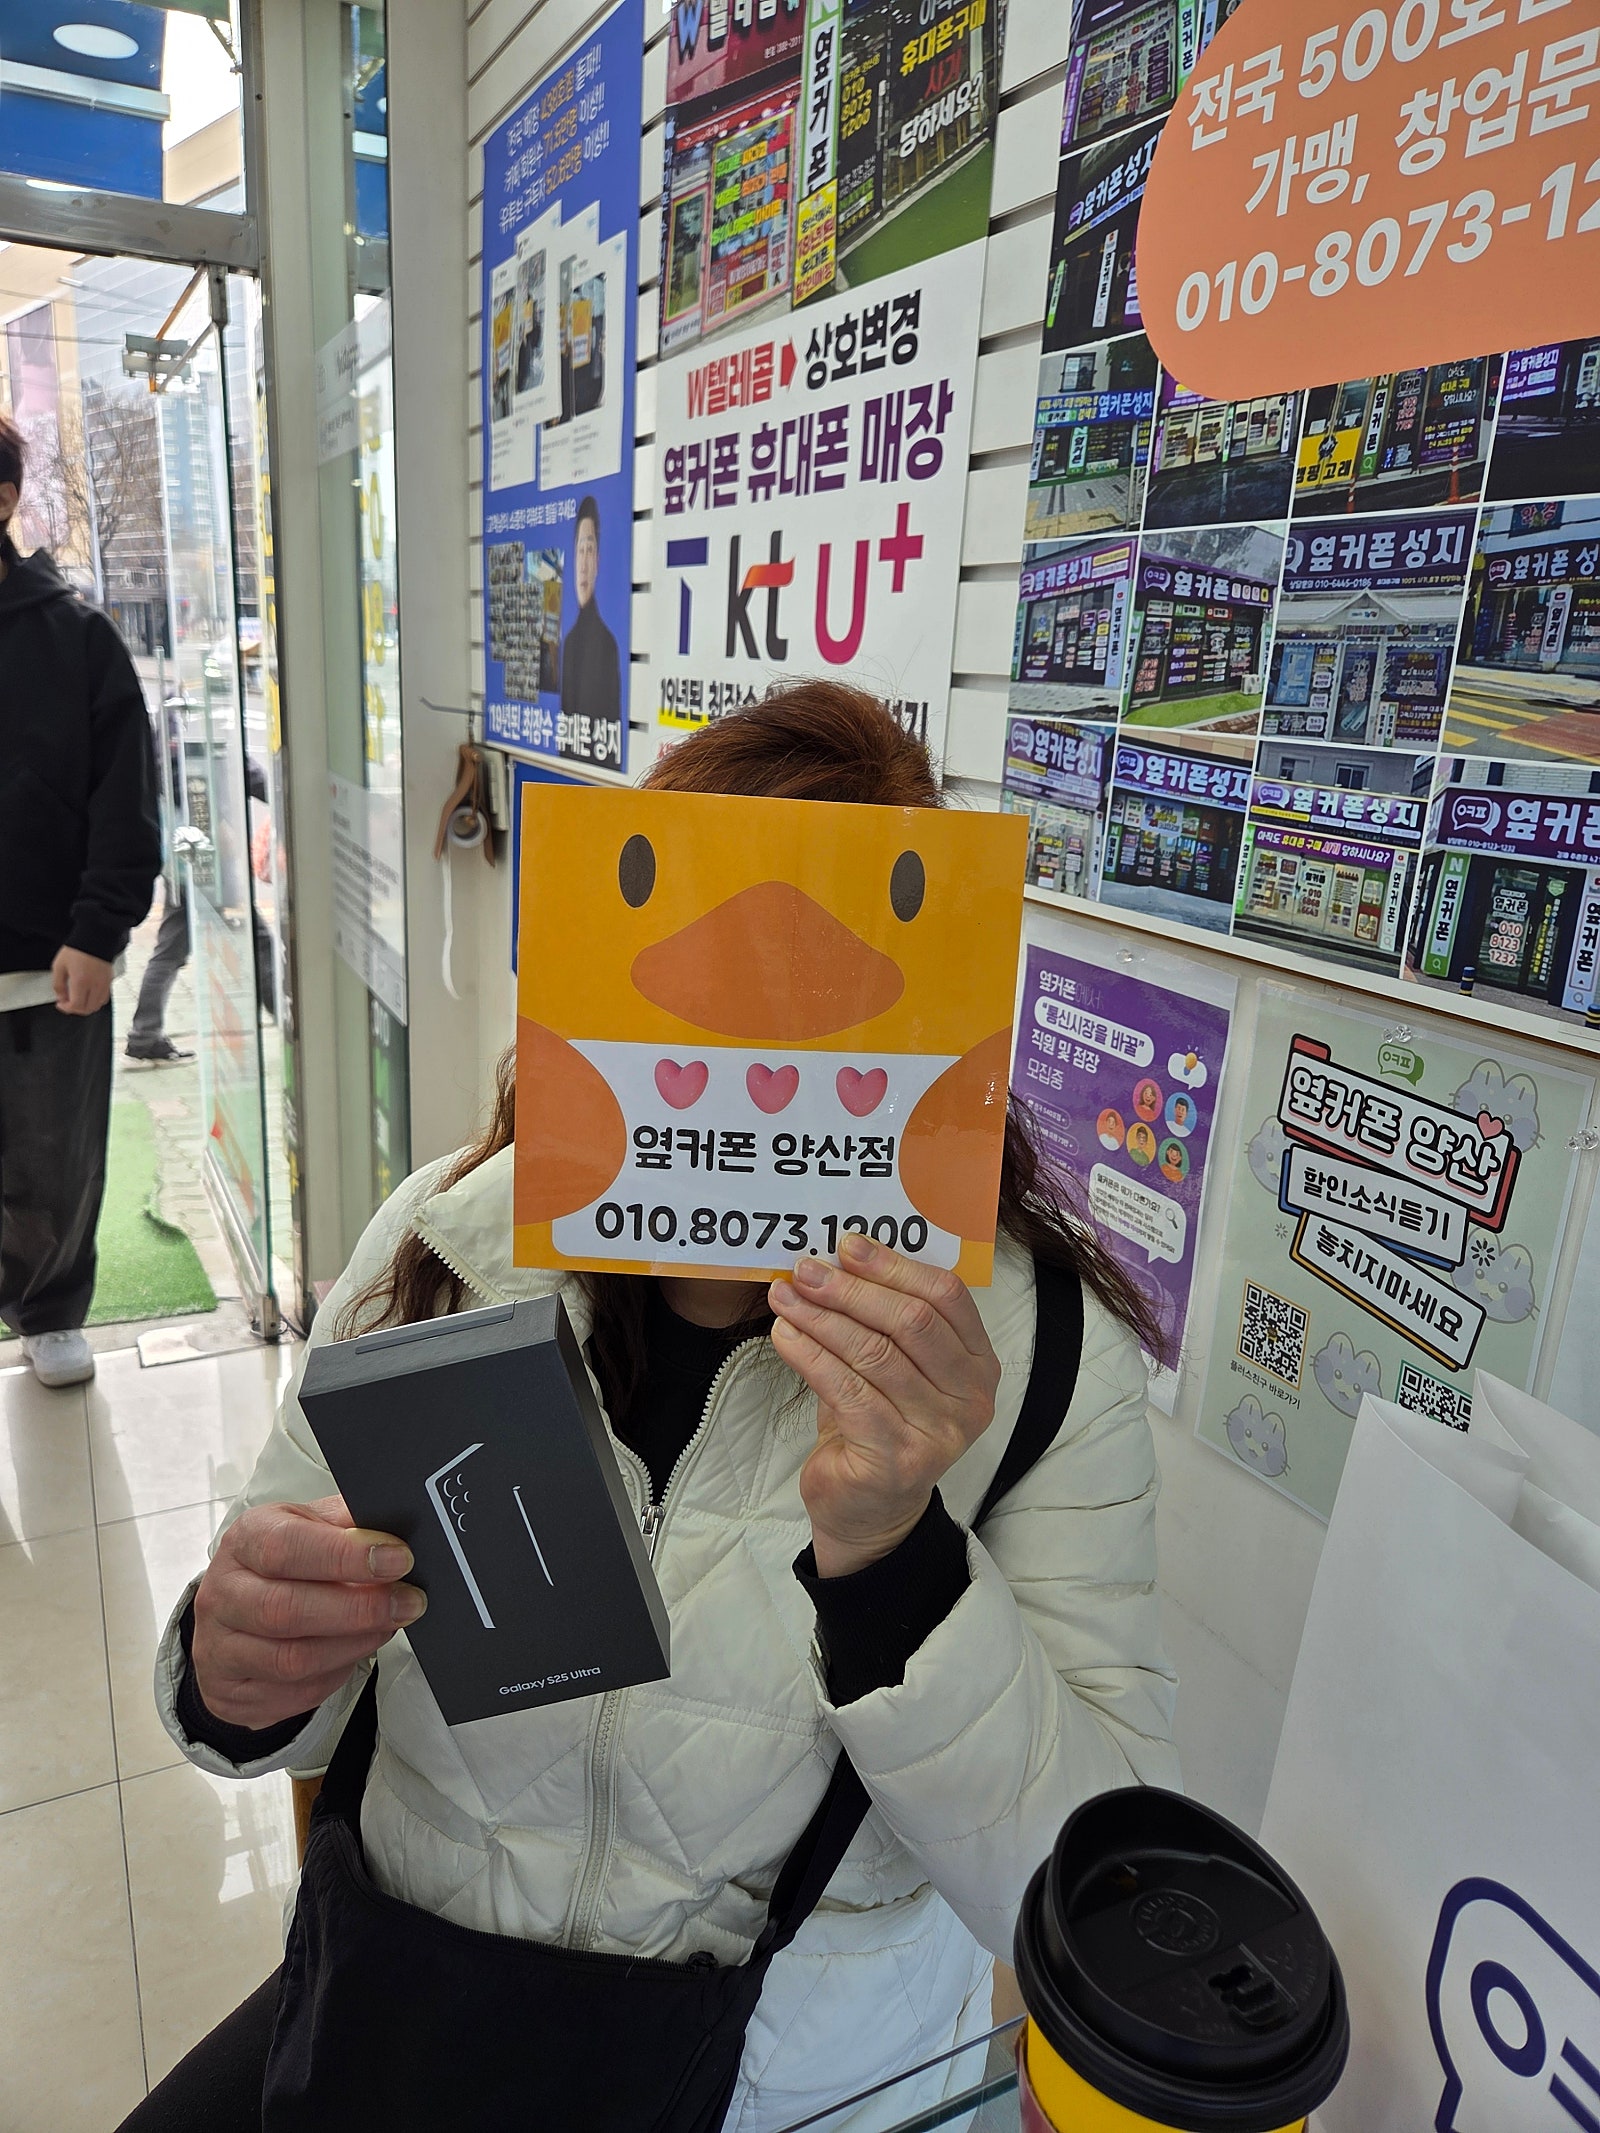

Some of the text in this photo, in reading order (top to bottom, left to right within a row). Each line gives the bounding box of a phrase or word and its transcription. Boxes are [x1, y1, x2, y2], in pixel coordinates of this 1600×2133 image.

[900, 72, 984, 158] 당하세요?
[1187, 44, 1284, 151] 전국
[1245, 113, 1371, 217] 가맹,
[688, 289, 921, 420] W텔레콤 상호변경
[664, 378, 955, 516] 옆커폰 휴대폰 매장
[725, 530, 796, 661] kt
[815, 502, 924, 666] U+
[1173, 570, 1230, 600] 옆커폰
[1513, 549, 1570, 580] 옆커폰
[661, 677, 705, 723] 19년된
[555, 711, 591, 758] 휴대폰
[592, 718, 622, 765] 성지
[1034, 728, 1103, 779] 옆커폰성지
[1145, 755, 1251, 801] 옆커폰성지
[1293, 788, 1420, 828] 옆커폰성지
[1257, 831, 1281, 844] 아직도
[1281, 834, 1305, 848] 휴대폰
[1305, 838, 1323, 851] 구매
[1341, 844, 1391, 864] 당하시나요?
[1435, 879, 1459, 941] 옆커폰
[1493, 896, 1528, 916] 옆커폰
[1499, 920, 1523, 937] 010
[1488, 949, 1517, 967] 1232
[1490, 934, 1520, 951] 8123
[1026, 1057, 1065, 1090] 모집중
[1031, 1028, 1101, 1074] 직원 및 점장
[632, 1125, 897, 1179] 옆커폰 양산점
[1290, 1067, 1502, 1196] 옆커폰 양산
[1303, 1167, 1451, 1241] 할인소식듣기
[1316, 1225, 1464, 1343] 놓치지마세요
[1229, 1360, 1302, 1411] 플러스친구 바로가기
[498, 1666, 602, 1696] Galaxy S25 Ultra
